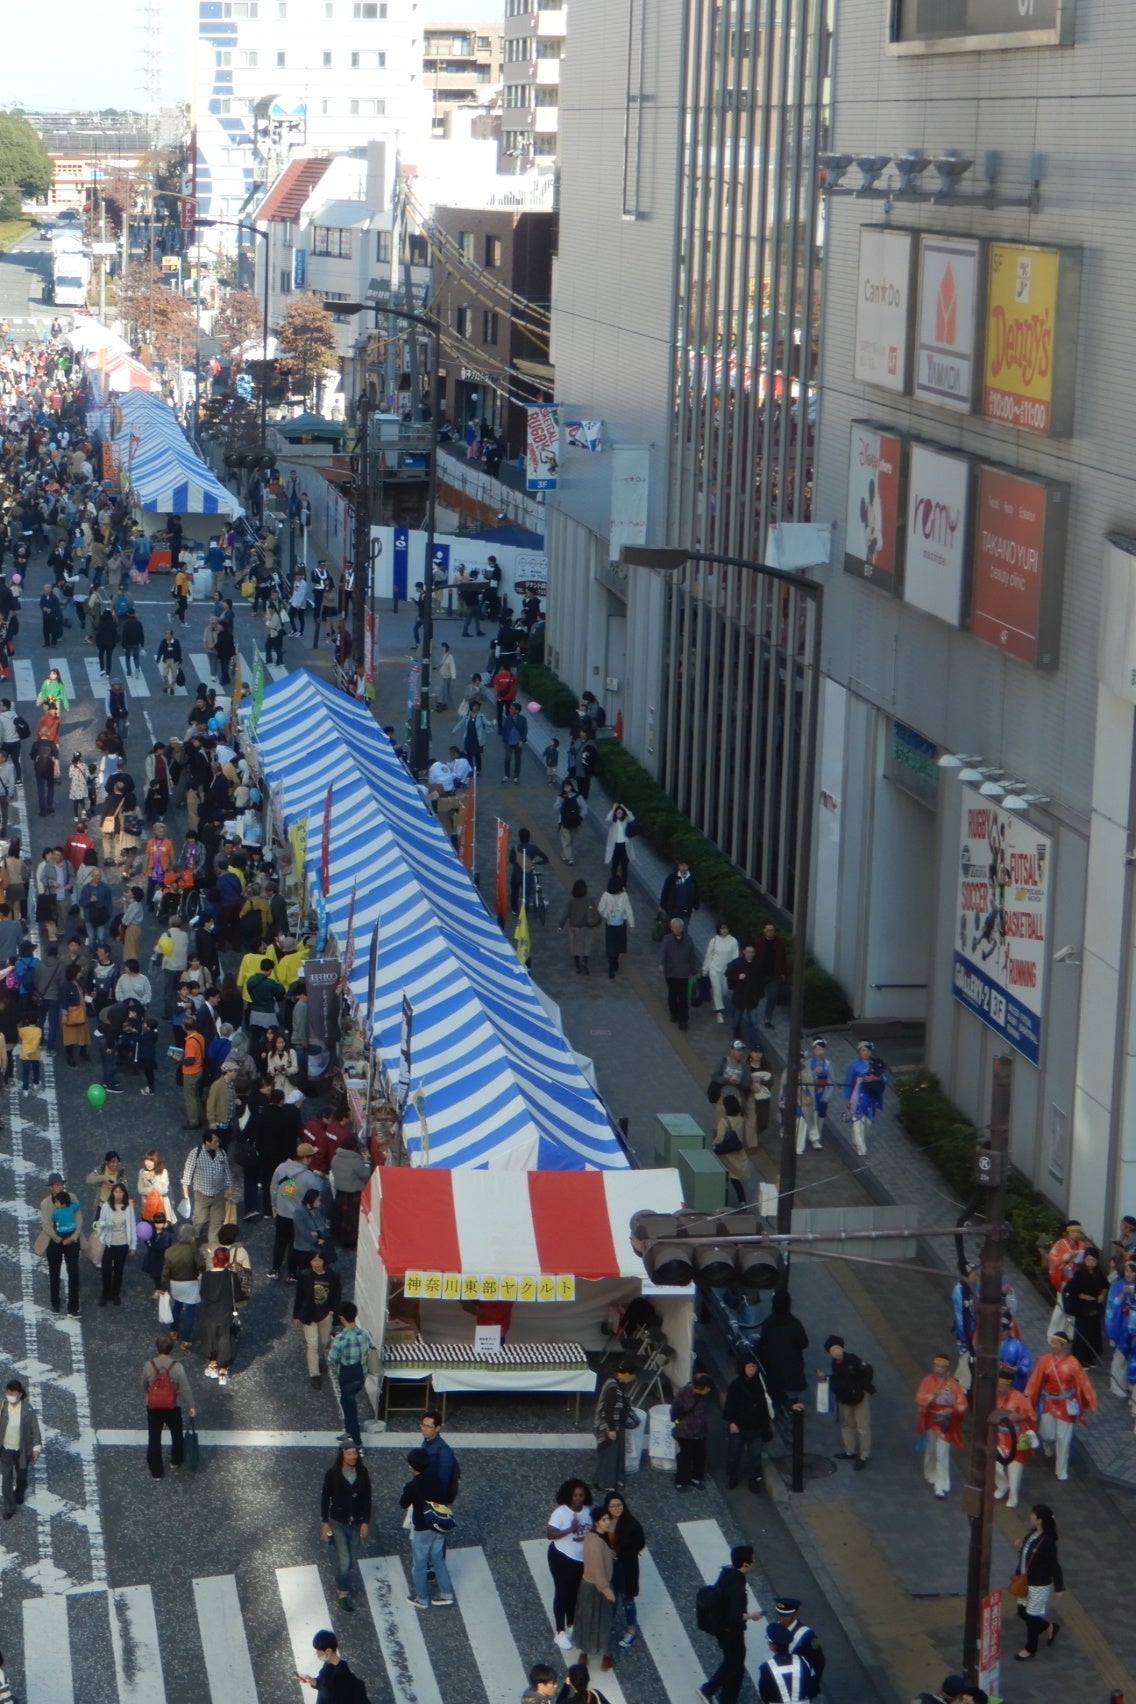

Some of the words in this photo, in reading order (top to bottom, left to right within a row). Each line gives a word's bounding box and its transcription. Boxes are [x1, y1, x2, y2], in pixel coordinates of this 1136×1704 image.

[991, 305, 1052, 386] Denny's
[528, 411, 550, 448] RUGBY
[537, 481, 548, 489] 3F
[982, 531, 1016, 564] TAKANO
[1017, 544, 1039, 573] YURI
[967, 808, 991, 840] RUGBY
[1010, 853, 1038, 887] FUTSAL
[961, 881, 989, 914] SOCCER
[1004, 910, 1044, 941] BASKETBALL
[1008, 957, 1037, 988] RUNNING
[407, 1277, 572, 1296] 神奈川東部ヤクルト
